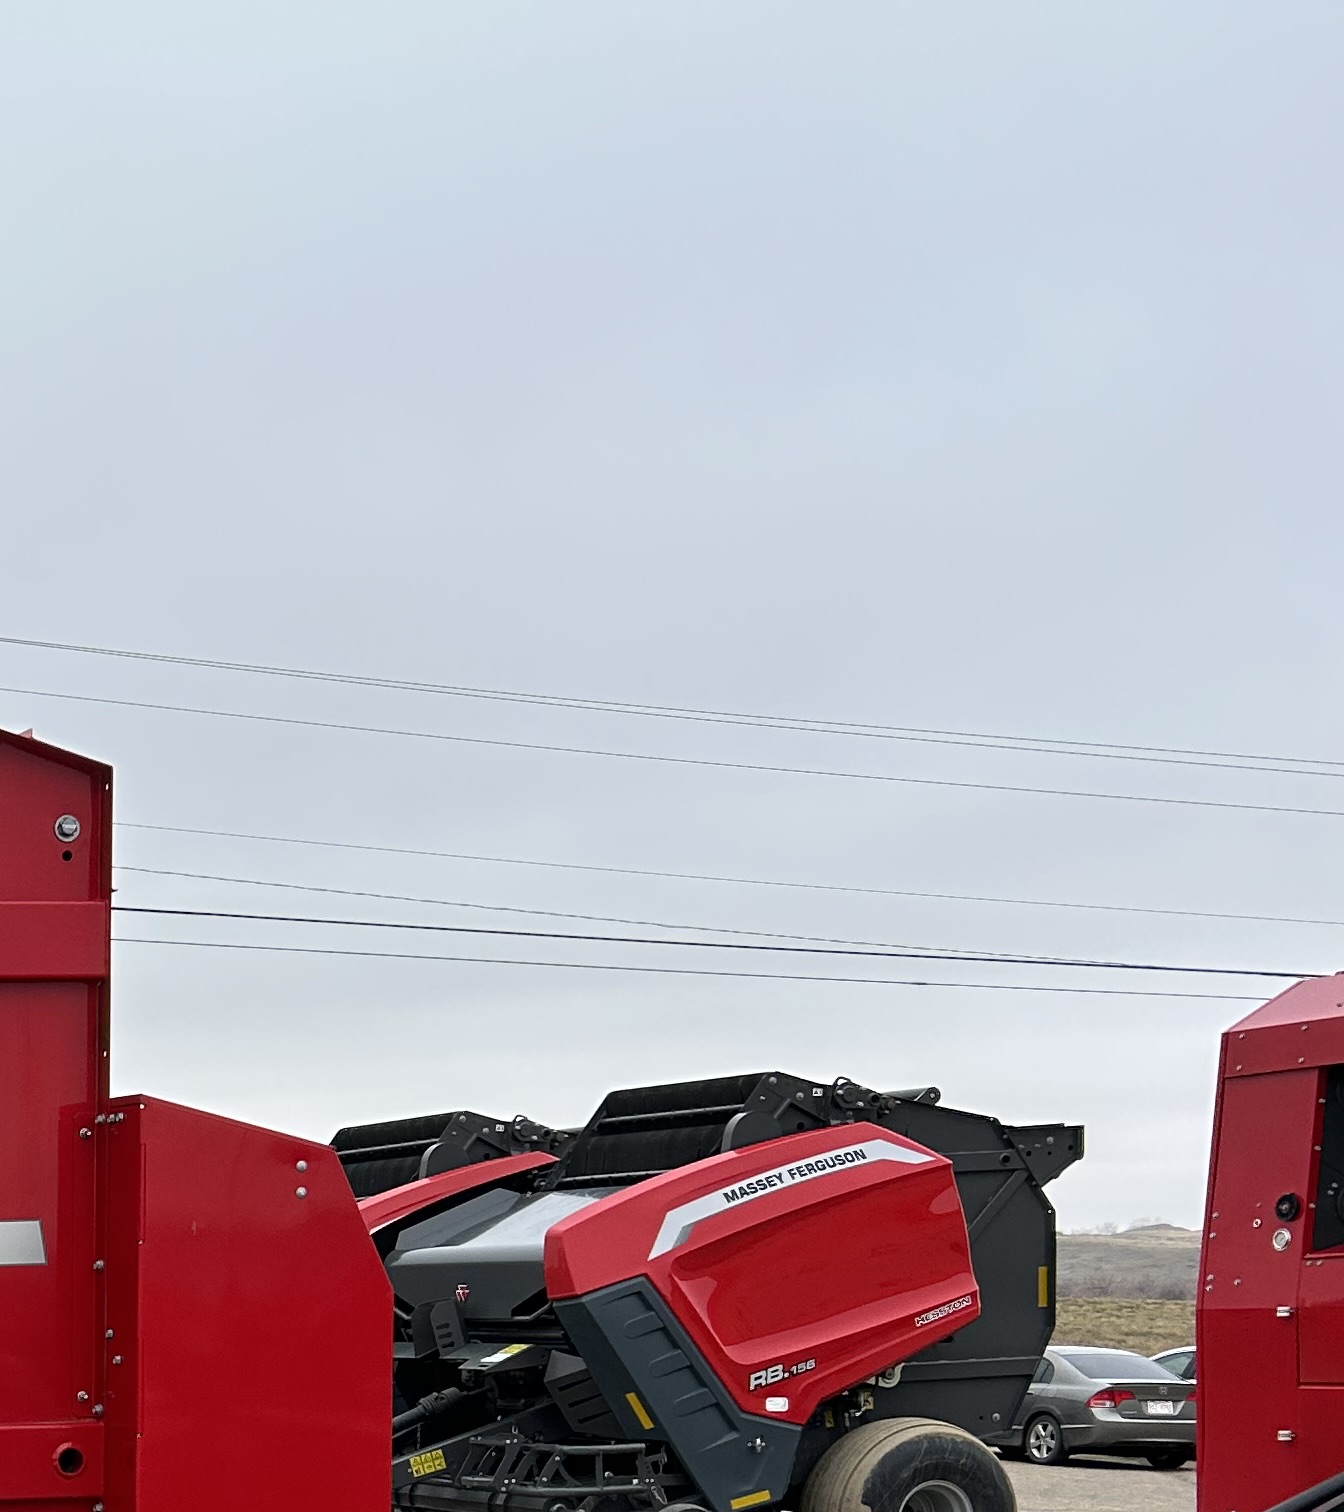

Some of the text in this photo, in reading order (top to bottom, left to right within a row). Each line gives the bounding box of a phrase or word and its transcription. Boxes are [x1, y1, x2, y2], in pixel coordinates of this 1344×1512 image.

[723, 1148, 868, 1204] MASSEY FERGUSON
[915, 1296, 972, 1327] HESSTON
